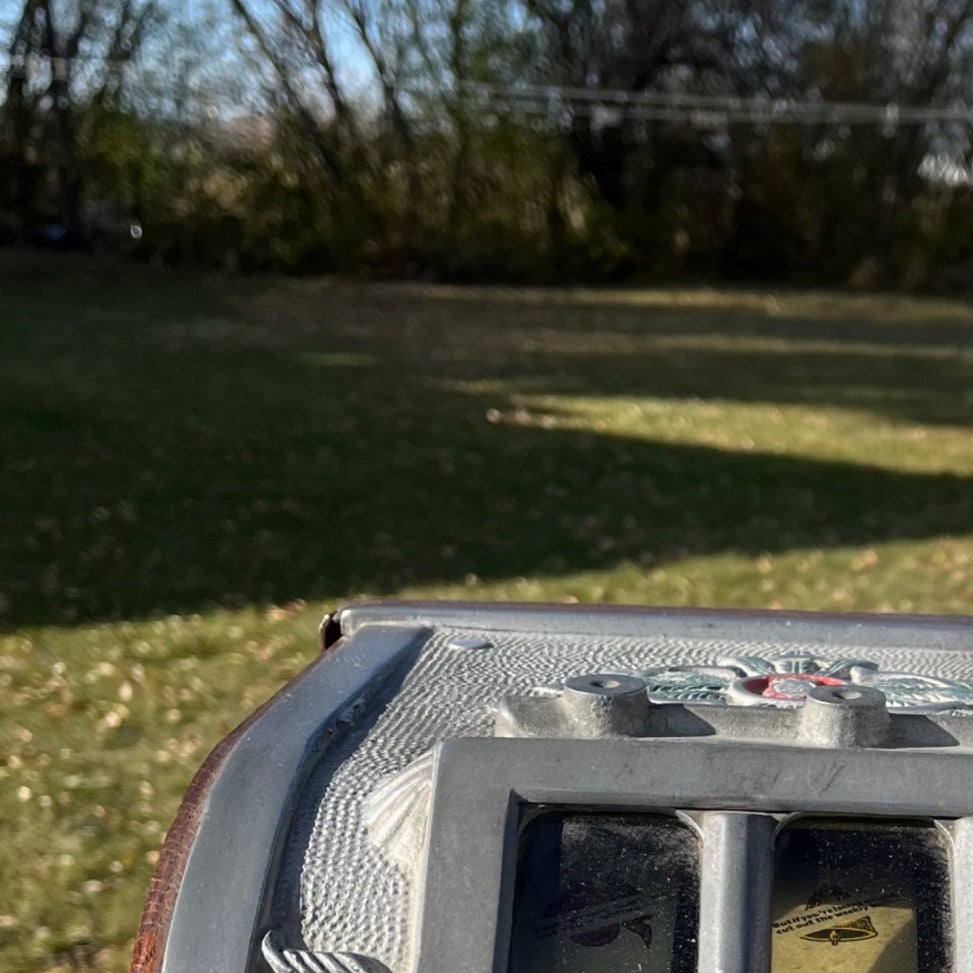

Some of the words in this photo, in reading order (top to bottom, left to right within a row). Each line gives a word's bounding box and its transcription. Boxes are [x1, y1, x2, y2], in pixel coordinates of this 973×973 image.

[776, 925, 793, 935] cut
[796, 919, 814, 929] out
[815, 914, 834, 924] the
